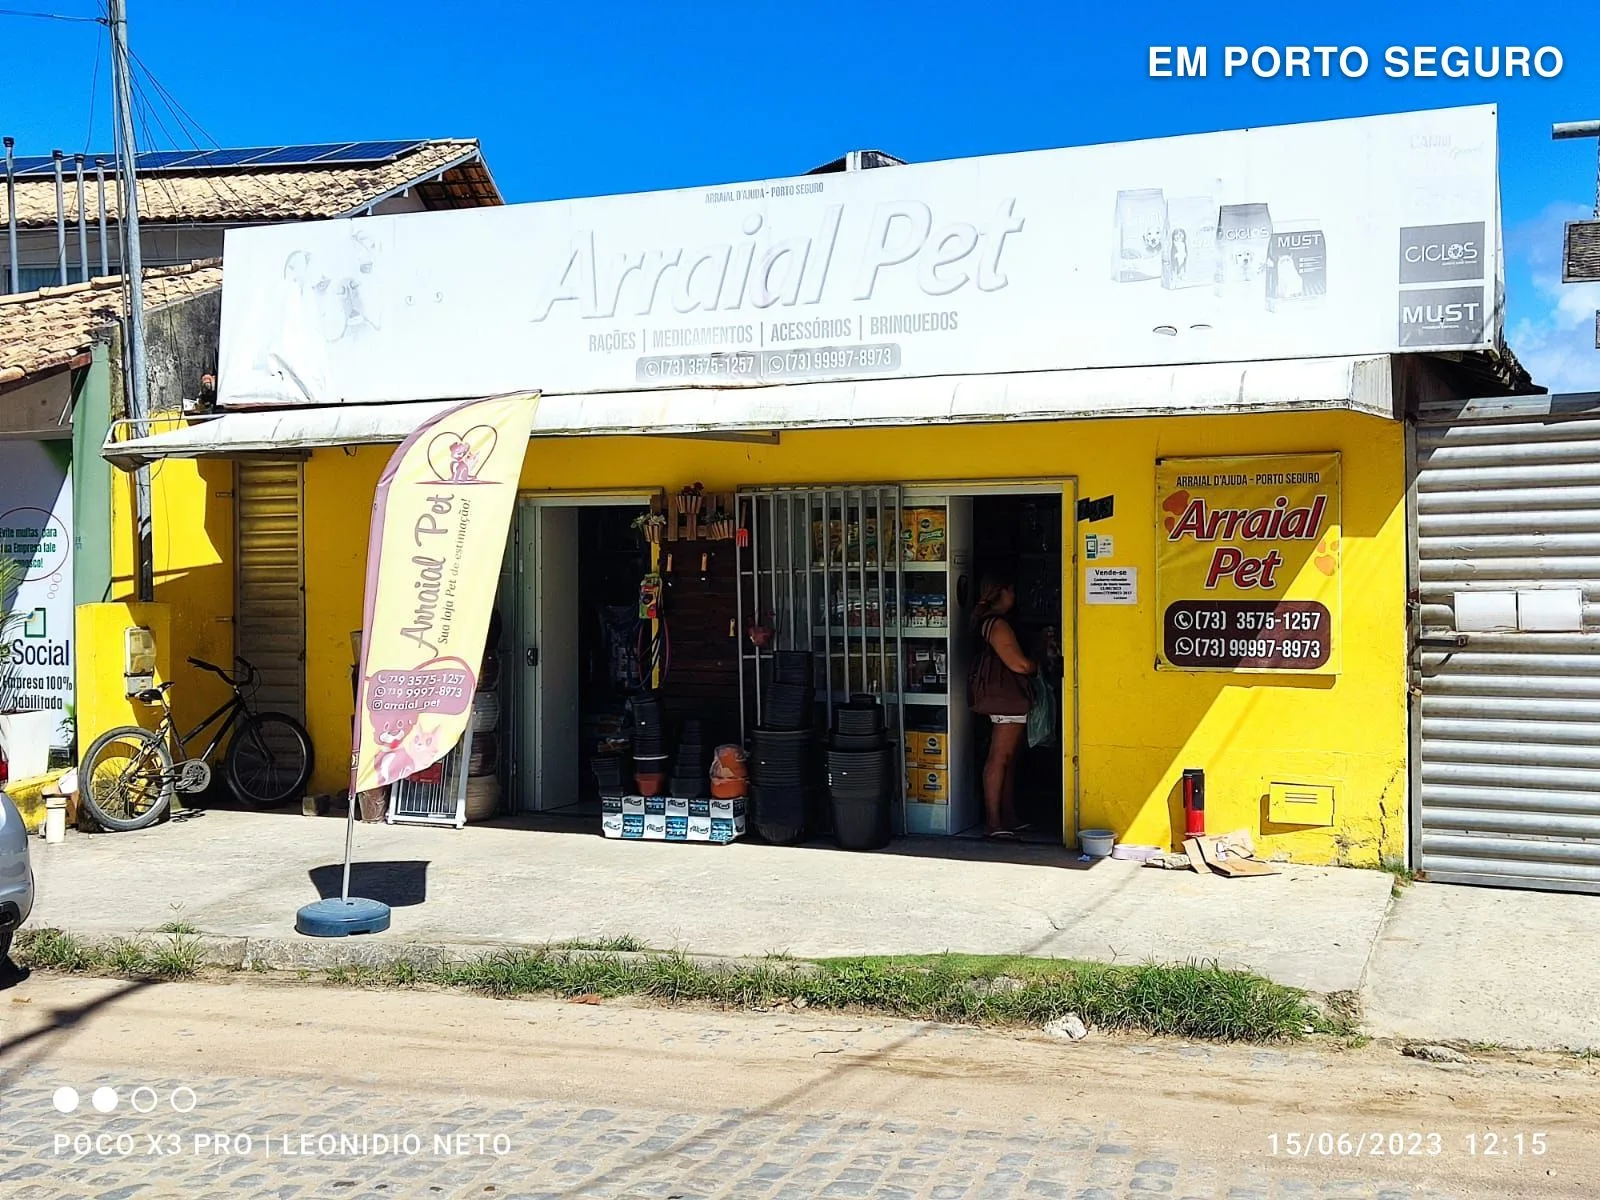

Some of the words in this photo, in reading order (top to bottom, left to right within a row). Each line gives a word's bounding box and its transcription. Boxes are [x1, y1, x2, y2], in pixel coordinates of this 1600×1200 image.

[705, 191, 735, 204] ARRAIAL
[771, 185, 795, 198] PORTO
[795, 182, 824, 195] SEGURO
[1277, 234, 1322, 248] MUST
[528, 203, 845, 322] Arraial
[852, 198, 1026, 301] Pet
[1404, 242, 1478, 263] CICLOS
[1402, 302, 1481, 324] MUST
[588, 329, 637, 354] RAÇÕES
[652, 325, 754, 349] MEDICAMENTOS
[770, 317, 852, 343] ACESSÓRIOS
[870, 311, 959, 336] BRINQUEDOS
[659, 358, 685, 376] (73)
[688, 356, 755, 375] 3575-1257
[785, 352, 811, 372] (73)
[814, 348, 892, 369] 99997-8973
[1176, 475, 1212, 487] ARRAIAL
[1213, 475, 1248, 487] D'AJUDA
[1255, 473, 1284, 485] PORTO
[1286, 472, 1320, 485] SEGURO
[414, 493, 455, 547] Pet
[455, 497, 472, 558] estimação!
[1168, 495, 1328, 541] Arraial
[450, 562, 460, 577] de
[1094, 568, 1128, 577] Vende-se
[1204, 546, 1282, 589] Pet
[445, 579, 458, 598] Pet
[400, 555, 446, 658] Arraial
[440, 600, 456, 623] loja
[1195, 610, 1227, 630] (73)
[1236, 611, 1321, 630] 3575-1257
[437, 624, 451, 645] Sua
[1, 638, 70, 666] Social
[1195, 638, 1225, 657] (73)
[1229, 639, 1321, 658] 99997-8973
[46, 675, 73, 691] 100%
[407, 673, 466, 686] 3575-1257
[406, 686, 463, 699] 9997-8973
[383, 699, 441, 711] arraial_pet
